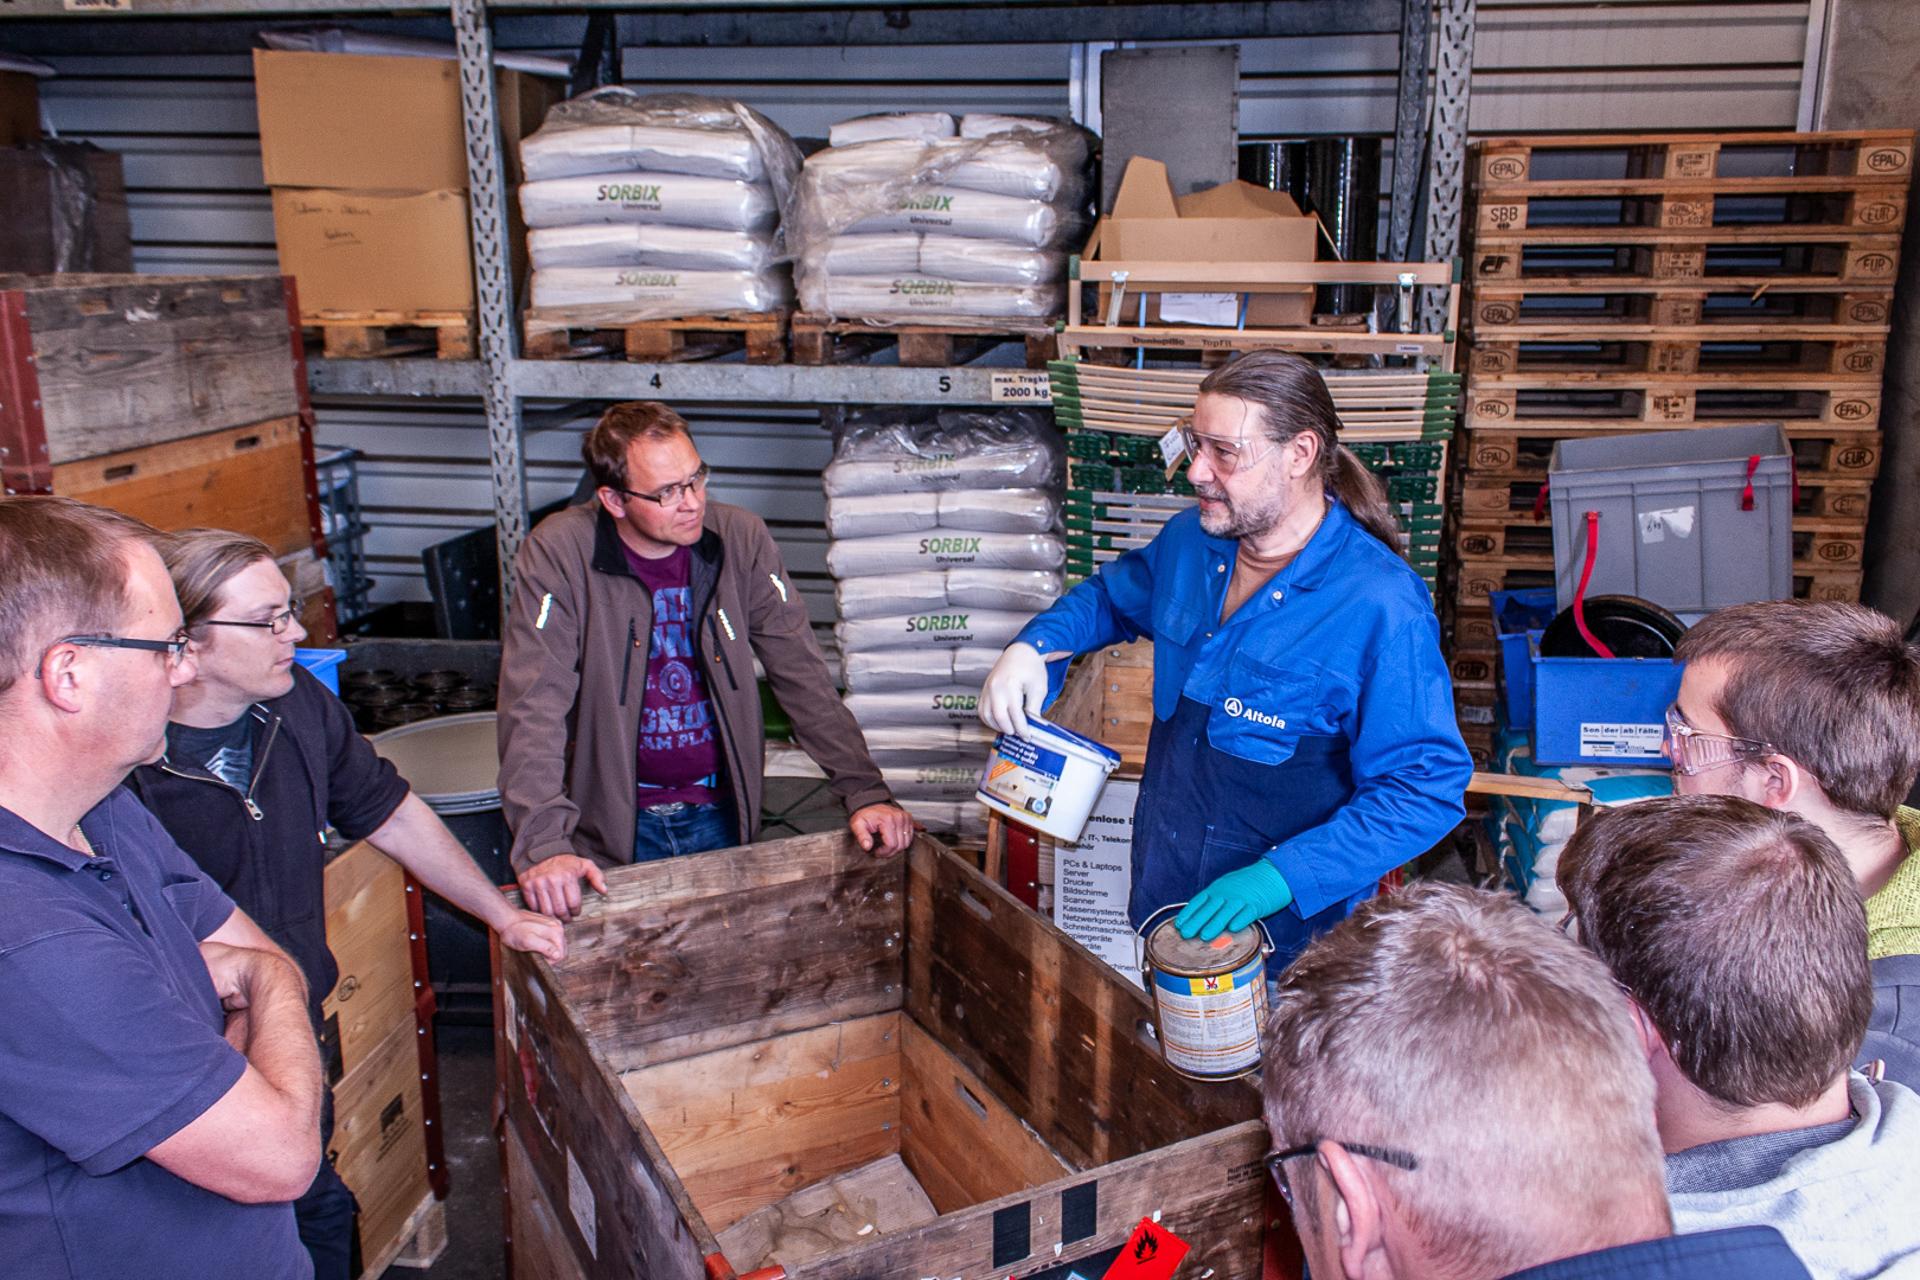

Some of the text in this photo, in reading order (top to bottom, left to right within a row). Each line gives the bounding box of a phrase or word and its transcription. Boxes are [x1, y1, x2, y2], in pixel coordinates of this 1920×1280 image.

[1872, 154, 1899, 167] EPAL
[597, 184, 661, 201] SORBIX
[1490, 206, 1518, 222] SBB
[1868, 206, 1889, 221] EUR
[910, 216, 952, 226] Universal
[615, 272, 679, 287] SORBIX
[889, 279, 955, 295] SORBIX
[1851, 356, 1873, 369] EUR
[650, 373, 662, 389] 4
[939, 376, 951, 392] 5
[1019, 376, 1048, 385] Tragkr
[1003, 388, 1030, 397] 2000
[1845, 450, 1866, 461] EUR
[919, 537, 981, 555] SORBIX
[1826, 544, 1848, 558] EUR
[936, 556, 975, 564] Universal
[906, 614, 969, 633] SORBIX
[933, 634, 973, 642] Universal
[932, 694, 979, 710] SORB
[1243, 708, 1286, 730] Altola
[1087, 814, 1126, 825] enlose
[1063, 859, 1123, 873] PCs & Laptops
[1063, 868, 1090, 878] Server
[1063, 877, 1094, 887] Drucker
[1063, 886, 1109, 898] Bildschirme
[1063, 895, 1096, 905] Scanner
[1063, 904, 1125, 917] Kassensysteme
[1063, 913, 1130, 926] Netzwerkprodukt
[1063, 922, 1135, 936] Schreibmaschinen
